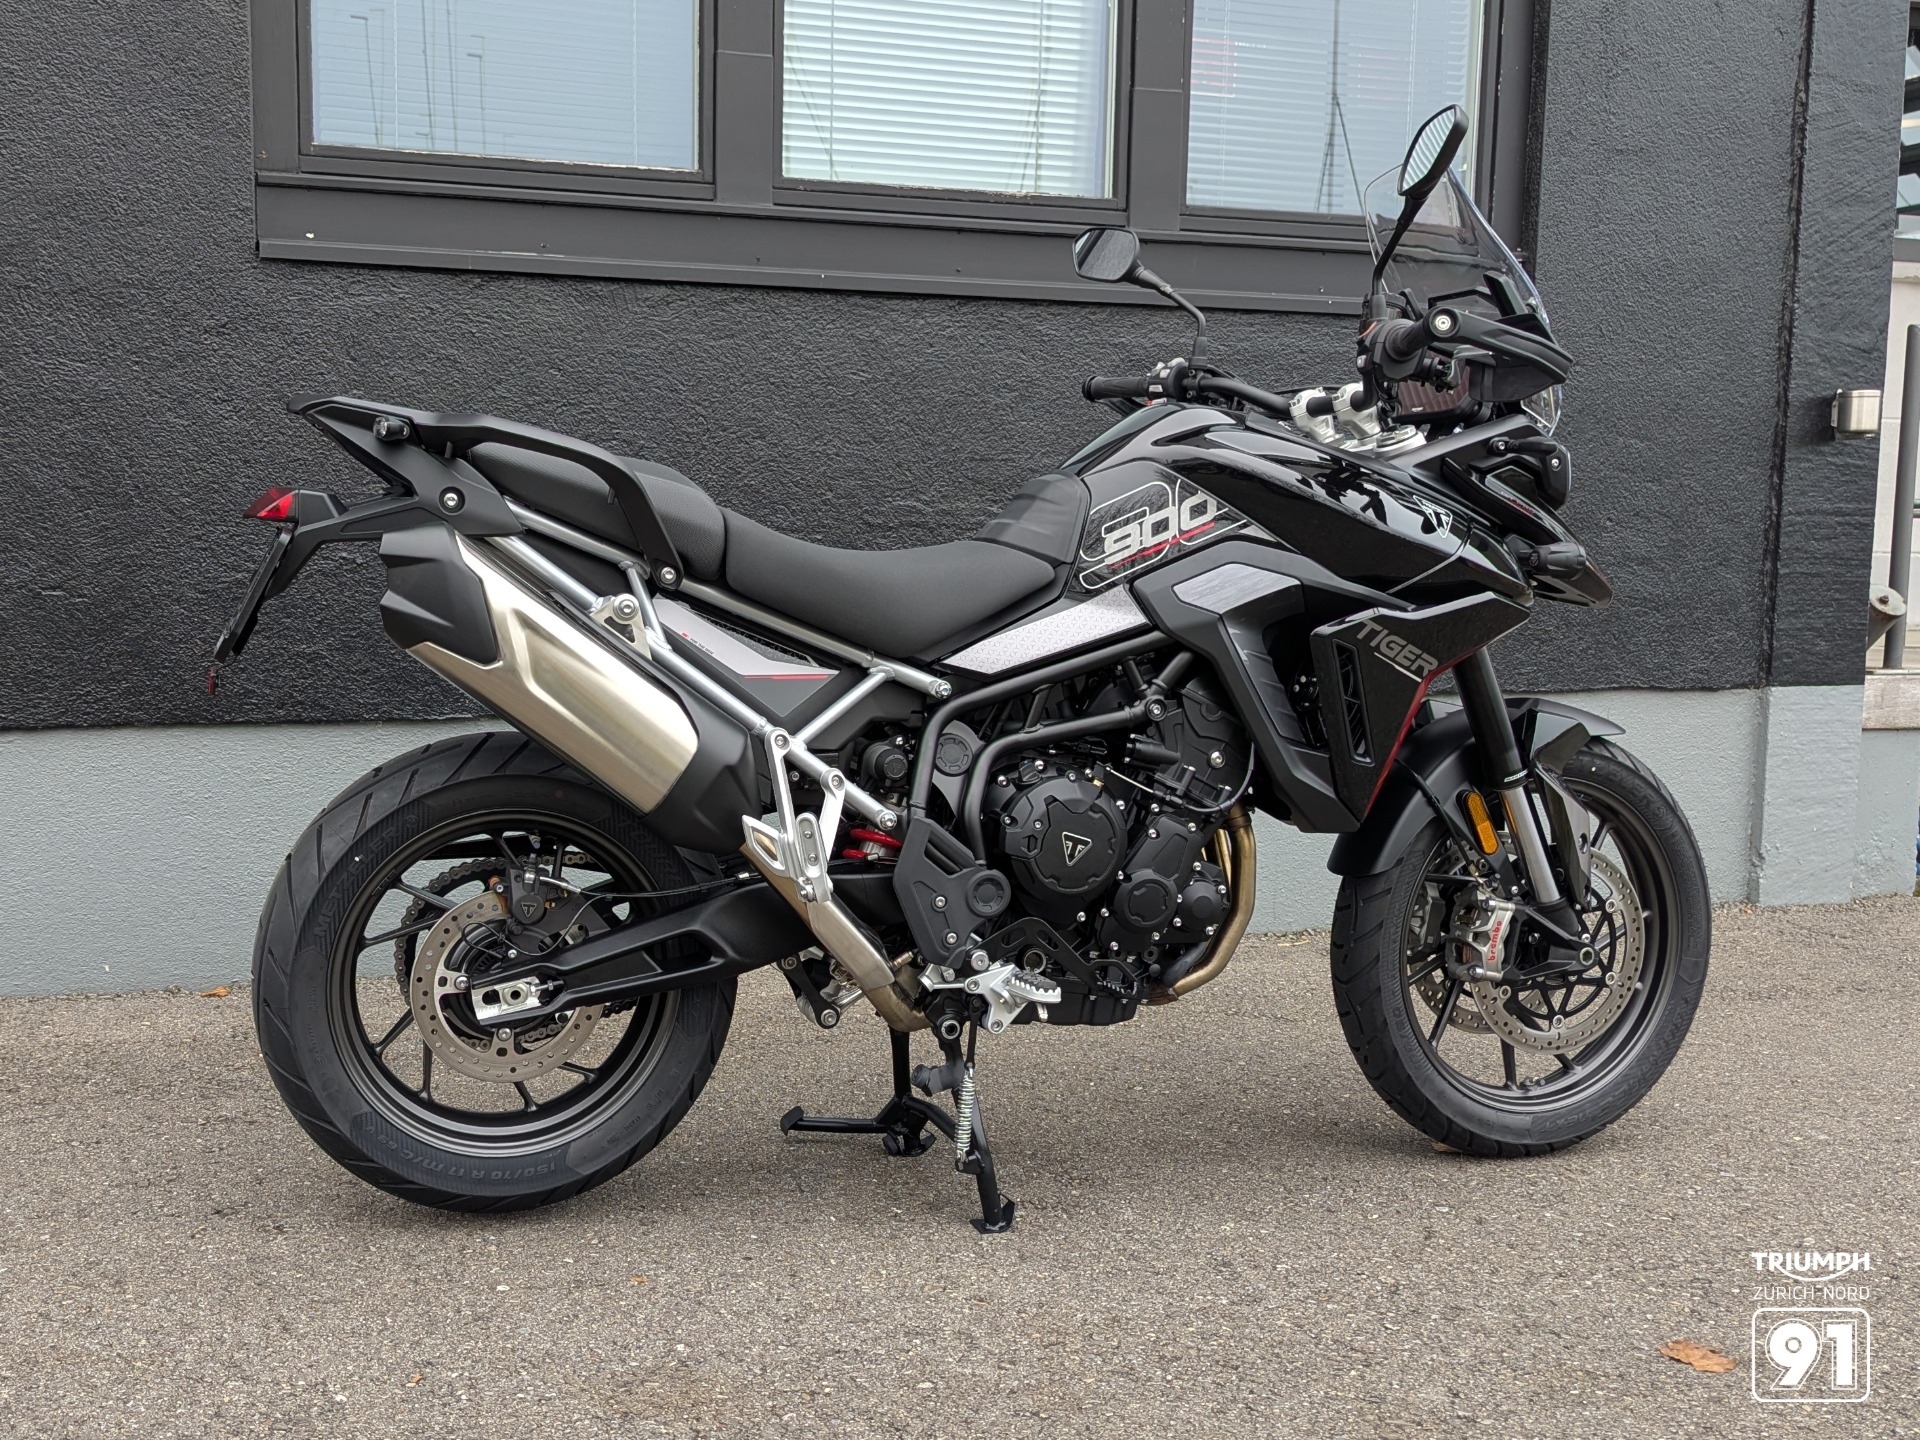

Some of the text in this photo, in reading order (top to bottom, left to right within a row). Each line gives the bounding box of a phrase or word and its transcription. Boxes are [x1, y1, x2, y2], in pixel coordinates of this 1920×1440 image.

[1356, 619, 1439, 678] TIGER
[312, 825, 401, 937] METZELER
[1487, 920, 1502, 962] brembo
[491, 1162, 555, 1180] 150/70
